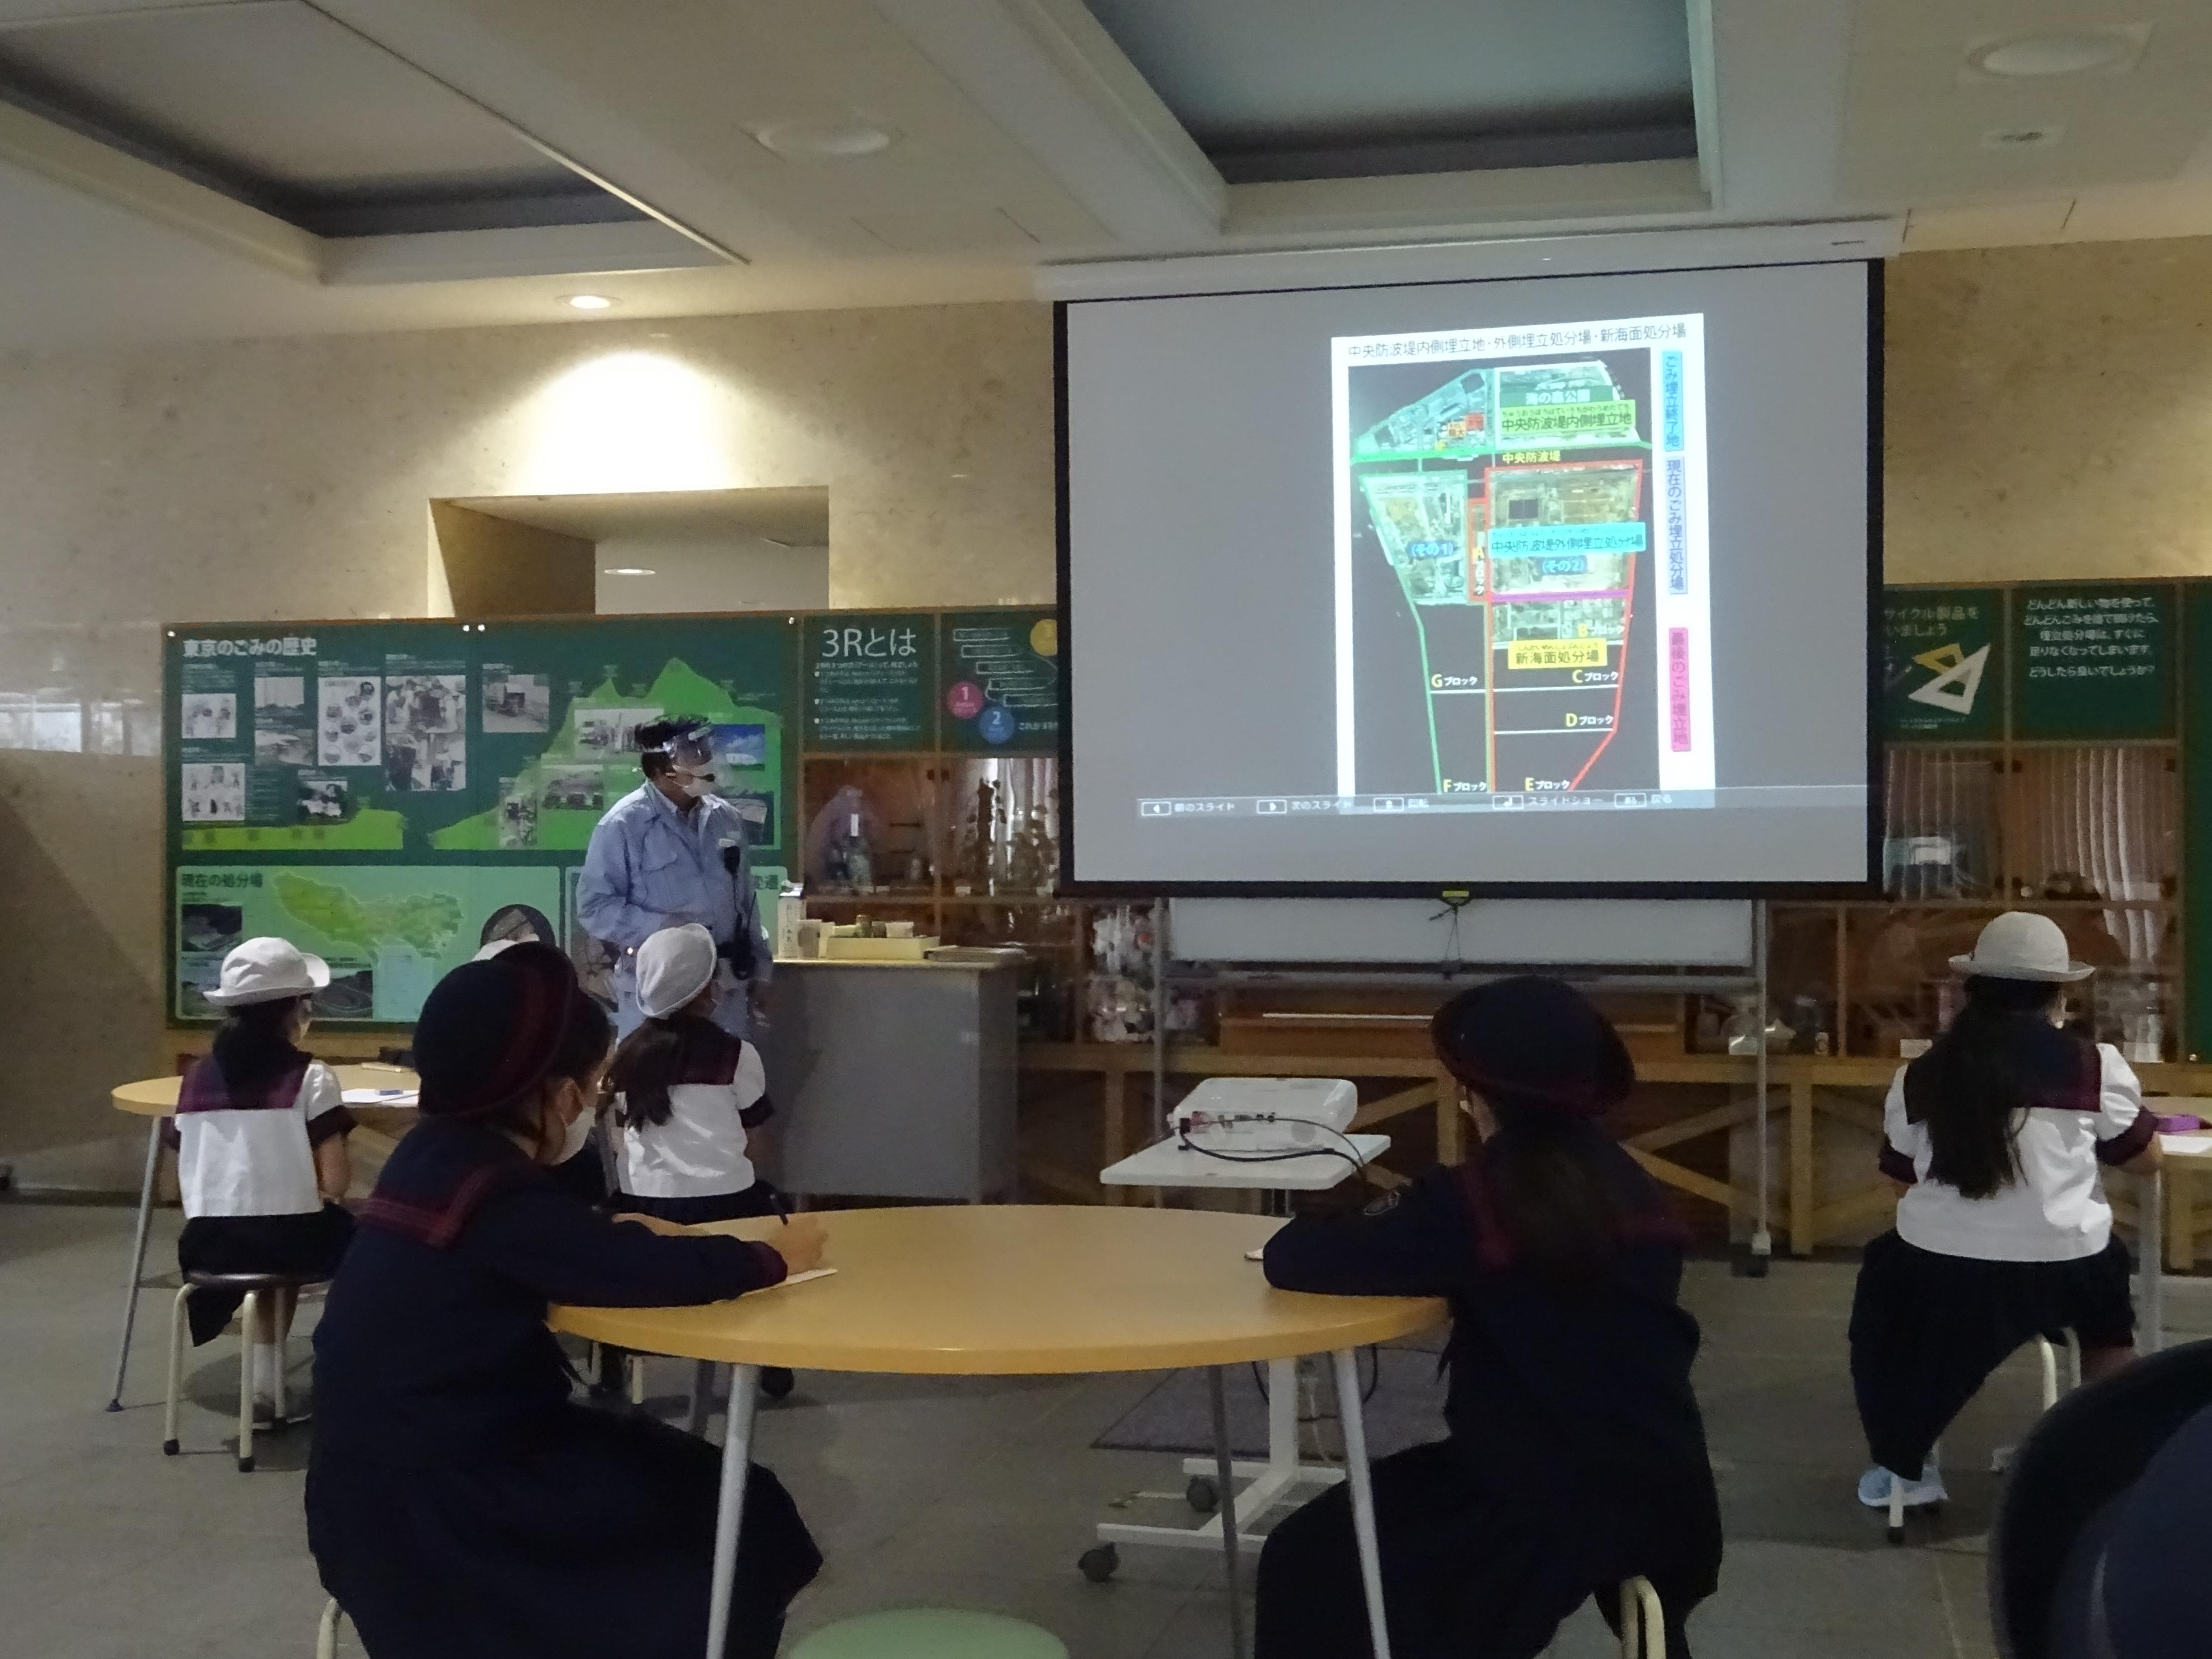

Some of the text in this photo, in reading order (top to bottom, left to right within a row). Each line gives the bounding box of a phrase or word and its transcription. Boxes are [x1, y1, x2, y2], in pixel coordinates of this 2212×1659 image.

[1348, 322, 1686, 358] 中央防波堤内側埋立地・外側埋立処分場・新海面処分場
[1502, 413, 1632, 431] 中央防波堤内側埋立地
[1502, 450, 1561, 464] 中央防波堤
[1667, 459, 1684, 590] 現在のごみ埋立処分場
[1491, 534, 1644, 553] 中央防波堤外側埋立処分場
[1542, 558, 1584, 573] (その2)
[183, 637, 316, 657] 東京のごみの歴史
[822, 628, 917, 657] 3Rとは
[1516, 649, 1599, 665] 新海面処分場
[961, 686, 969, 701] 1
[992, 711, 1001, 725] 2
[1528, 797, 1604, 806] スライドショー
